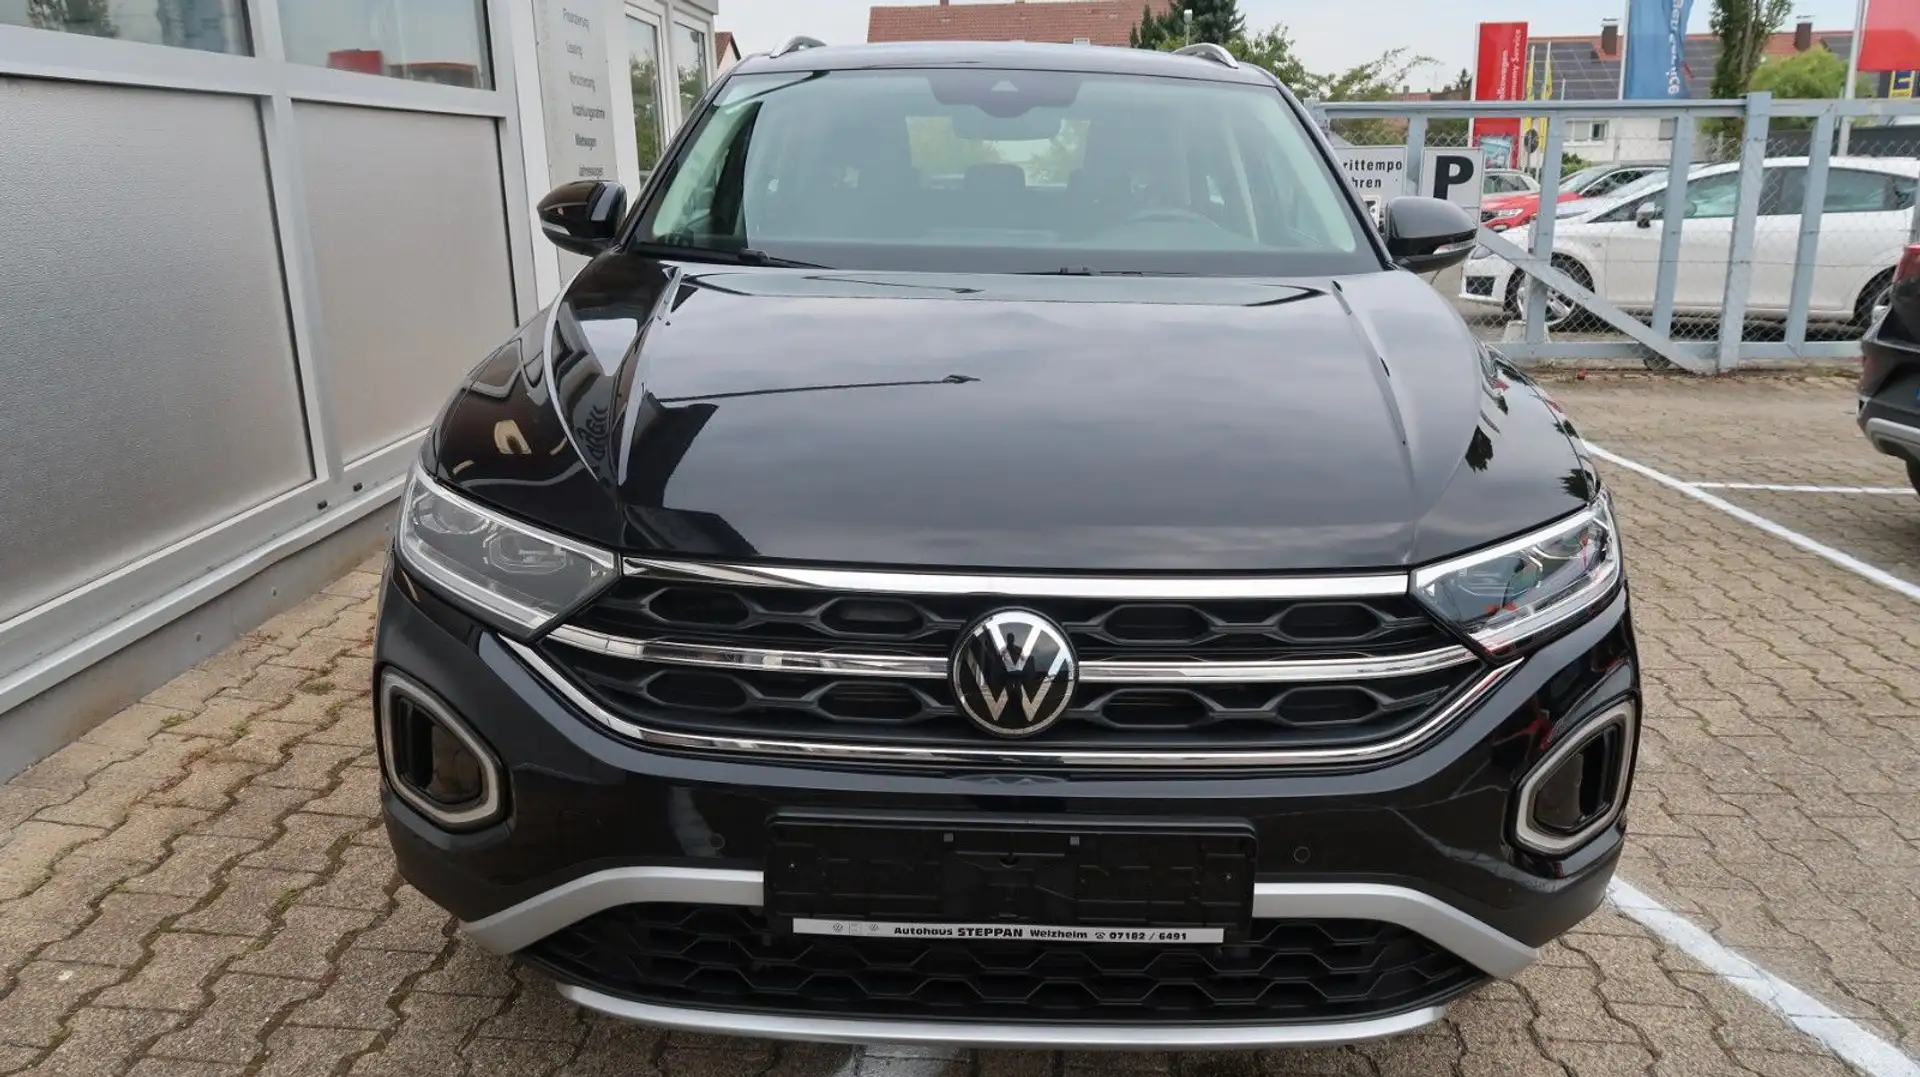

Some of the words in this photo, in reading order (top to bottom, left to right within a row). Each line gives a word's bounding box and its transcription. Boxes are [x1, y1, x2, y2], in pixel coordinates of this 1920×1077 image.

[1433, 155, 1475, 200] P
[894, 927, 953, 936] Autohaus
[957, 927, 1023, 938] STEPPAN
[1030, 929, 1087, 939] Welzheim
[1109, 932, 1145, 940] 07182
[1158, 933, 1187, 941] 6491
